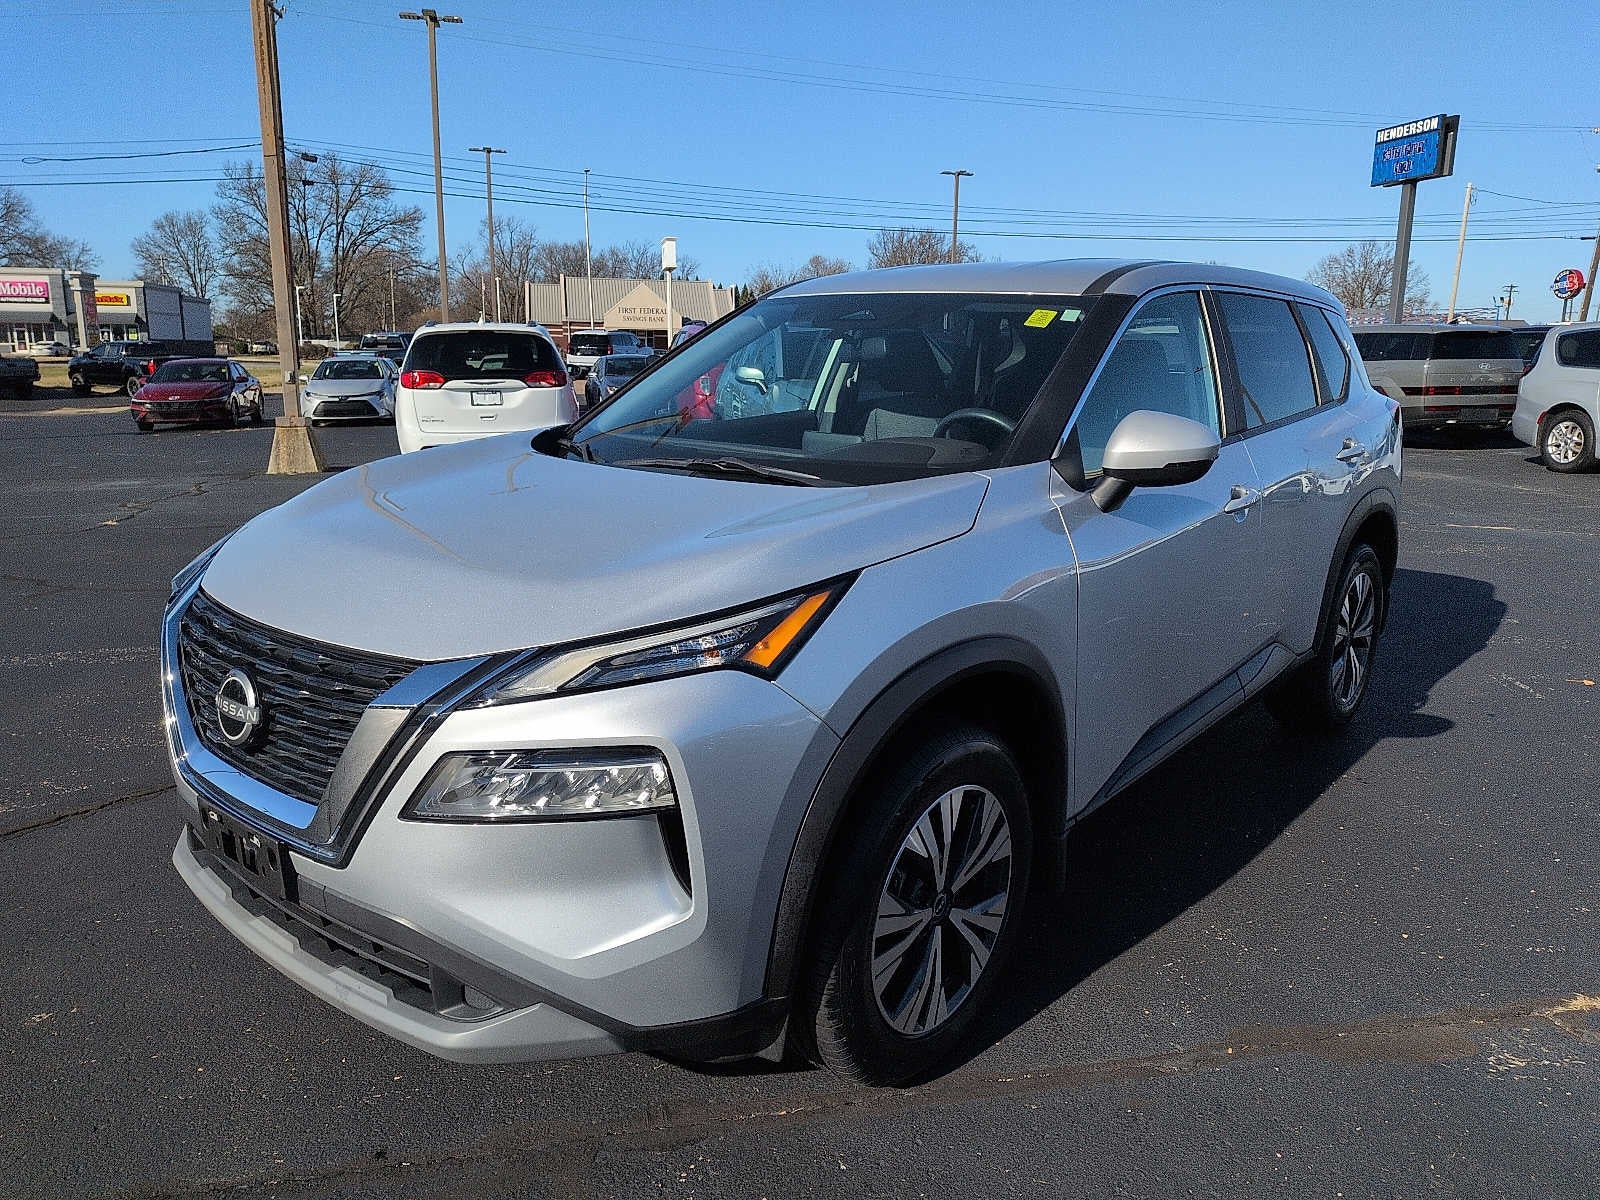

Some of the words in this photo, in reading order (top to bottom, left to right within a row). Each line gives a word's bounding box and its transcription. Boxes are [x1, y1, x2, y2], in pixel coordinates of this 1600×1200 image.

[1377, 117, 1439, 143] HENDERSON
[0, 281, 44, 296] Mobile
[618, 306, 637, 314] FIRST
[639, 307, 668, 315] FEDERAL
